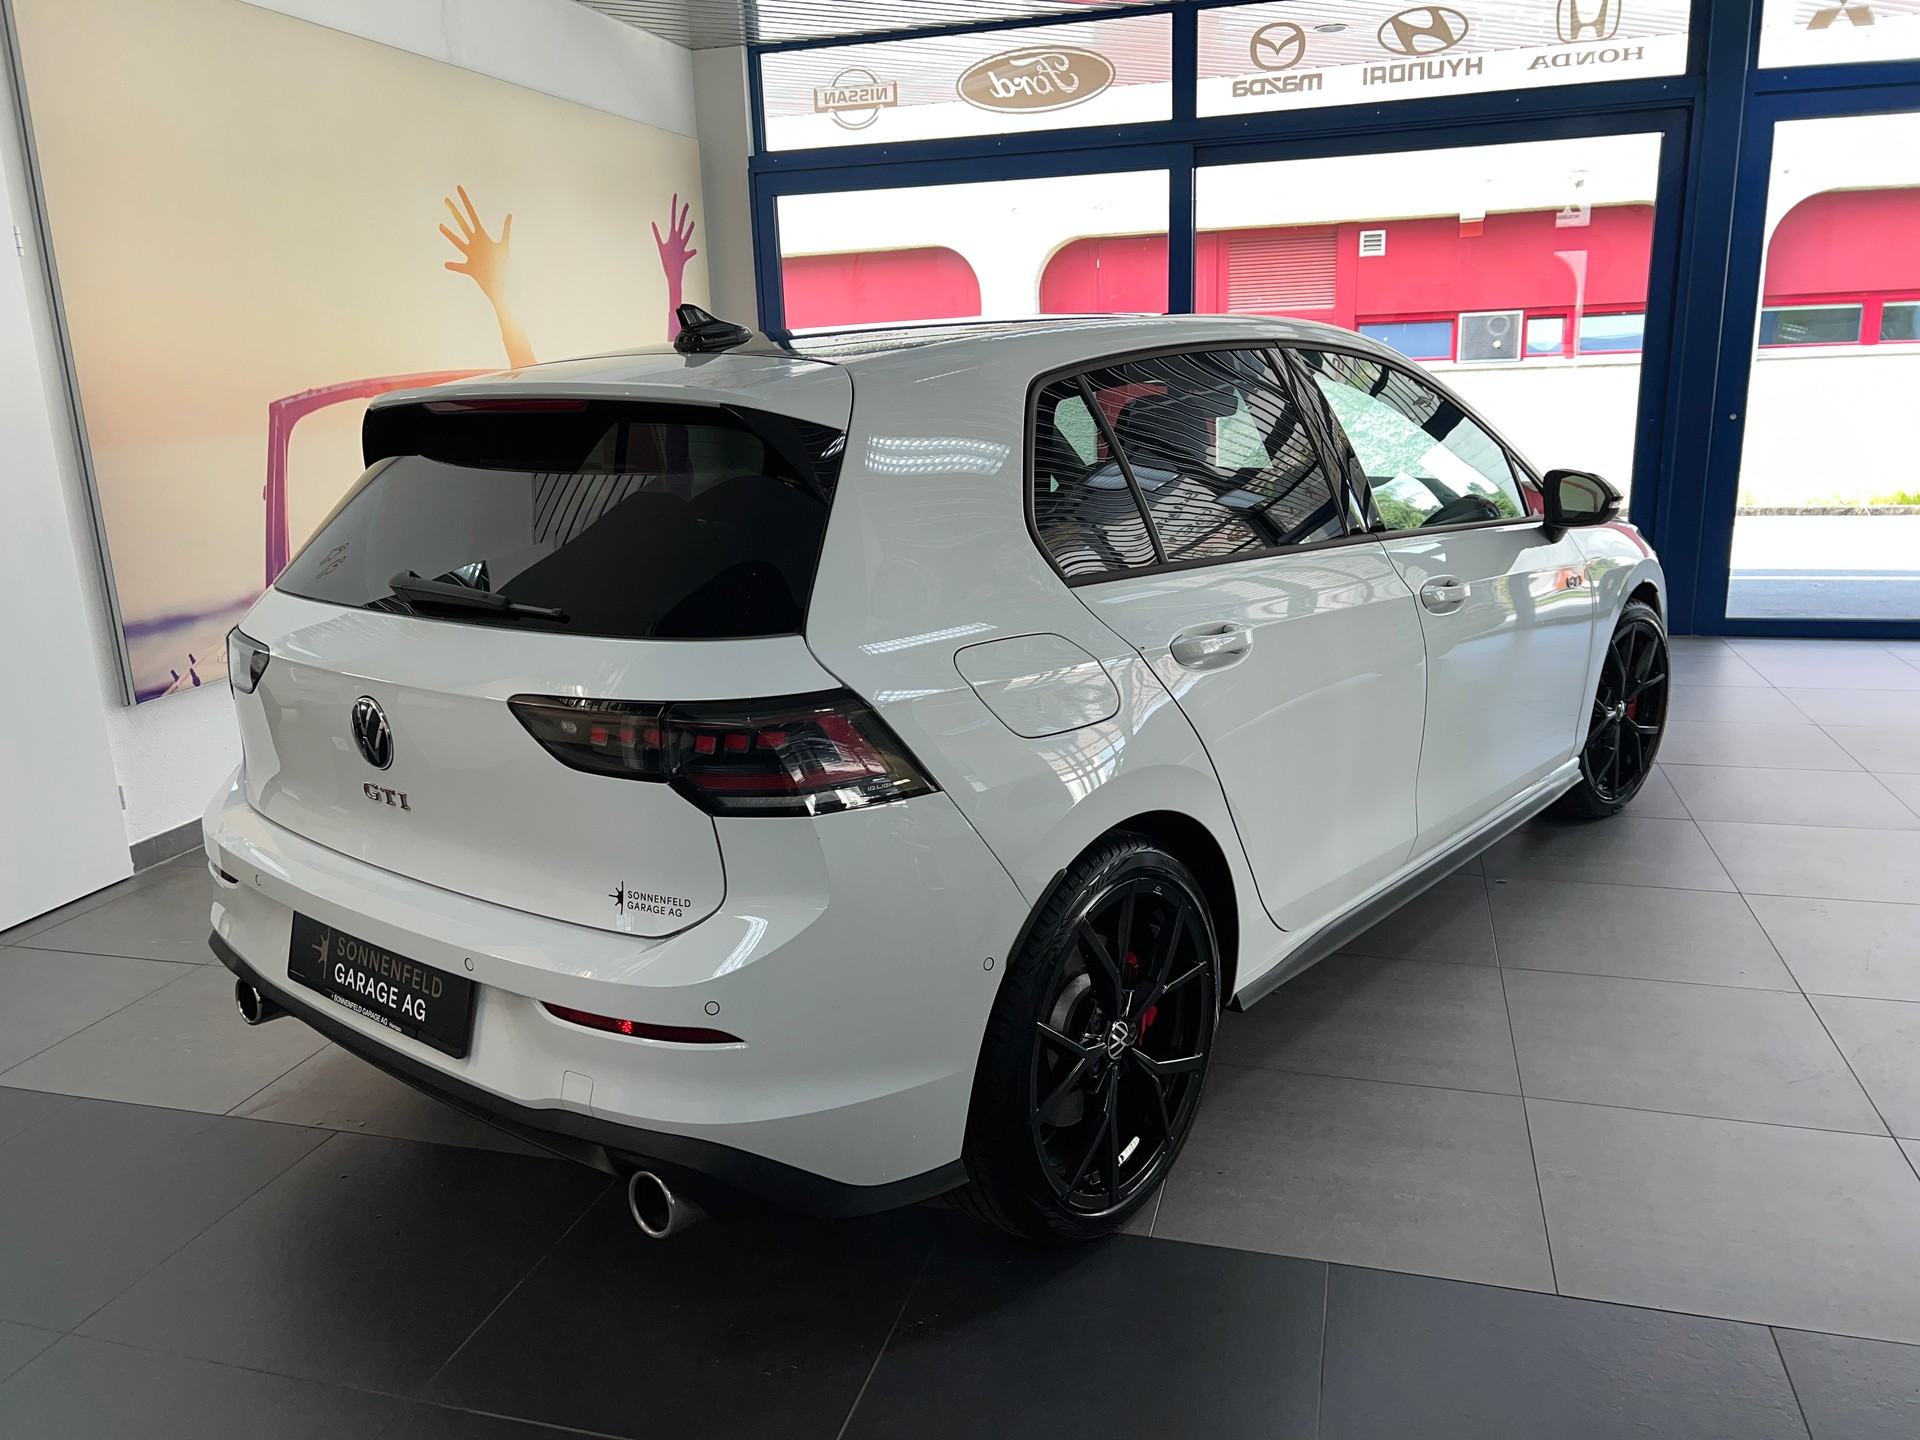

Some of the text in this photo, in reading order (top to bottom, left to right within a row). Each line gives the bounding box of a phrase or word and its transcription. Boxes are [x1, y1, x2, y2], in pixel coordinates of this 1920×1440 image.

[363, 781, 411, 811] GTI
[627, 890, 691, 908] SONNENFELD
[627, 901, 683, 917] GARAGE AG
[336, 936, 443, 999] SONNENFELD
[334, 962, 427, 1022] GARAGE AG
[333, 994, 363, 1013] SONNENFELD
[362, 1007, 381, 1022] GARAGE
[381, 1016, 388, 1026] AG
